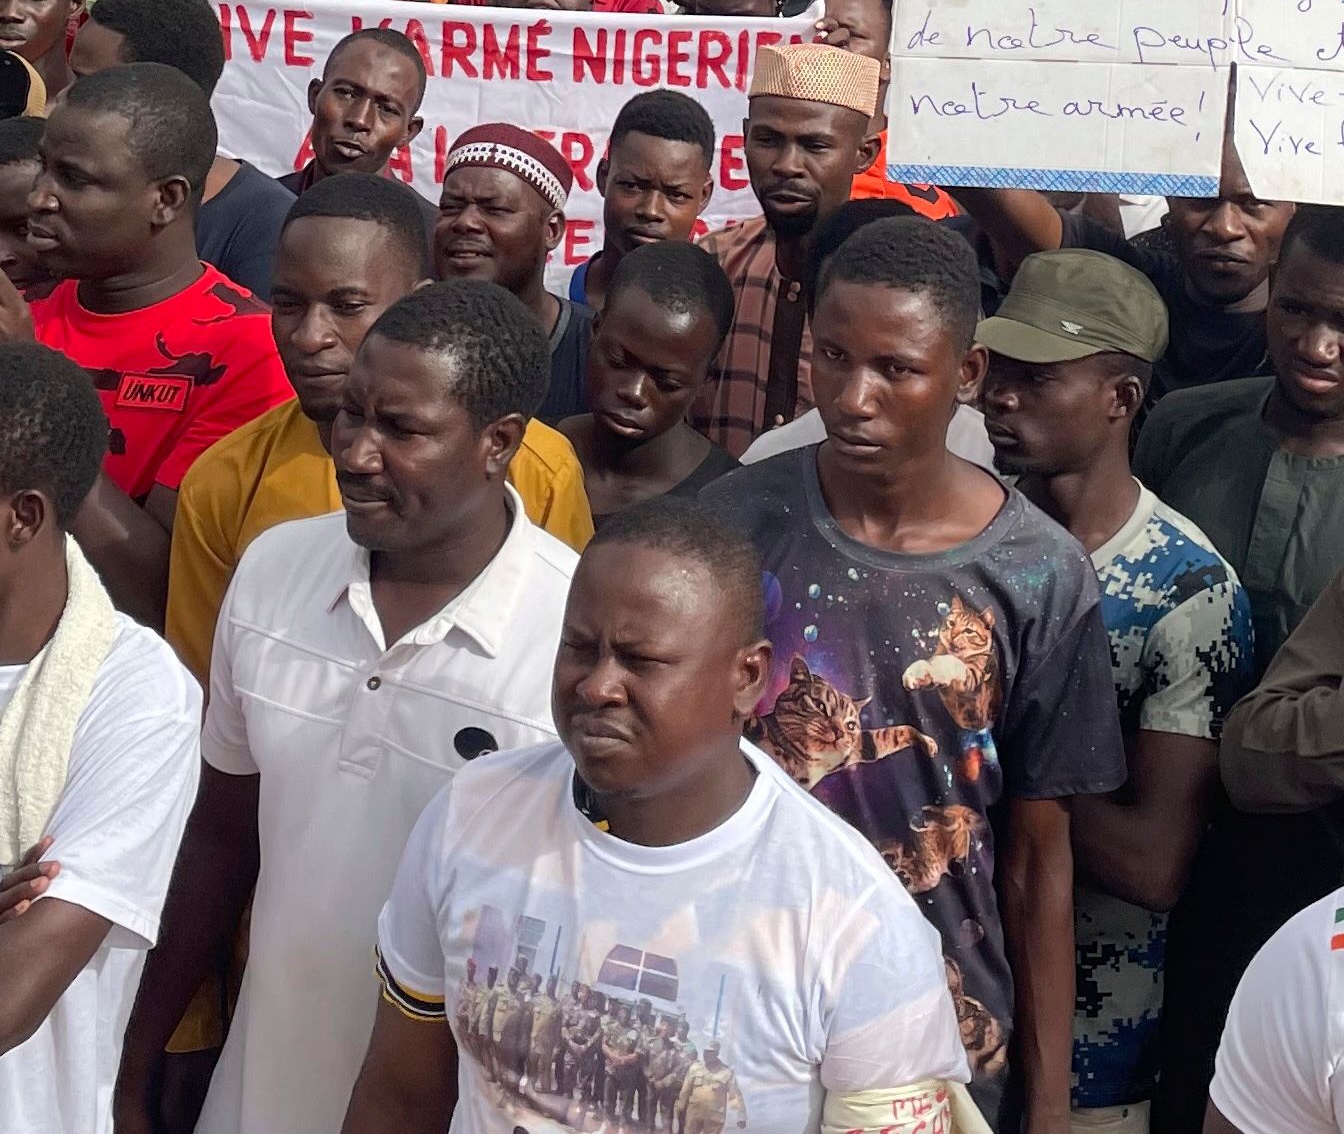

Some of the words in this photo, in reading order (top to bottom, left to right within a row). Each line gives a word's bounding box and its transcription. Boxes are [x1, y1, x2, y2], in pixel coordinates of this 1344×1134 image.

[218, 3, 315, 67] IVE
[572, 26, 823, 93] NIGERI
[908, 9, 944, 50] de
[1133, 16, 1292, 72] peuple
[909, 81, 1054, 120] notre
[1249, 70, 1336, 106] Vive
[1249, 119, 1323, 155] Vive
[123, 379, 183, 404] UNKUT
